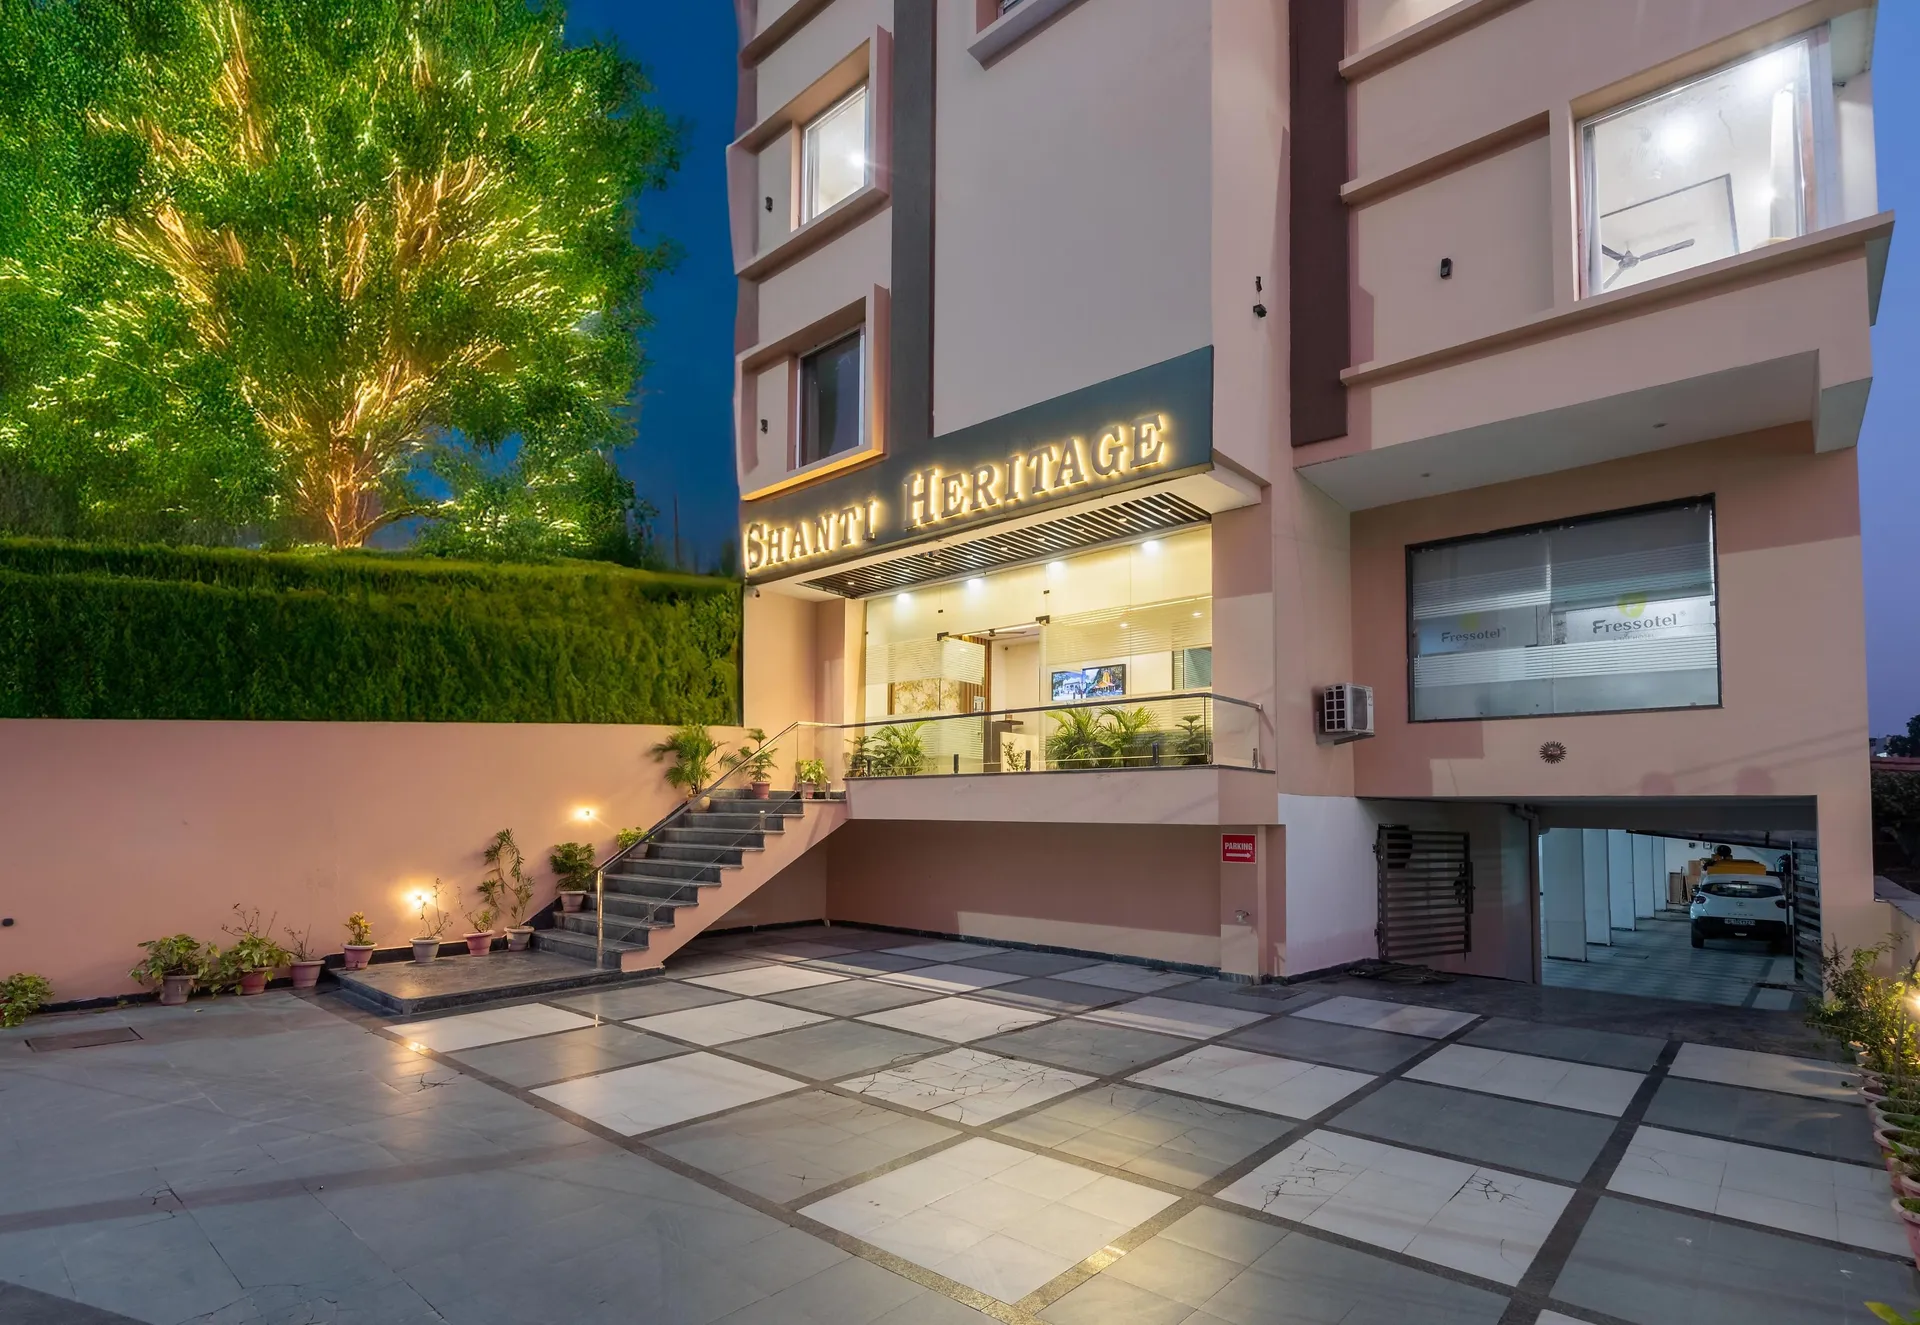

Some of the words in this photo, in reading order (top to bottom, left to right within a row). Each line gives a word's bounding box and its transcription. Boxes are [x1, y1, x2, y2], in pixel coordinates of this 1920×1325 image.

[744, 500, 878, 570] SHANTI
[904, 413, 1165, 531] HERITAGE
[1592, 613, 1677, 634] Fressotel
[1441, 628, 1500, 642] Fressotel
[1224, 842, 1253, 851] PARKING
